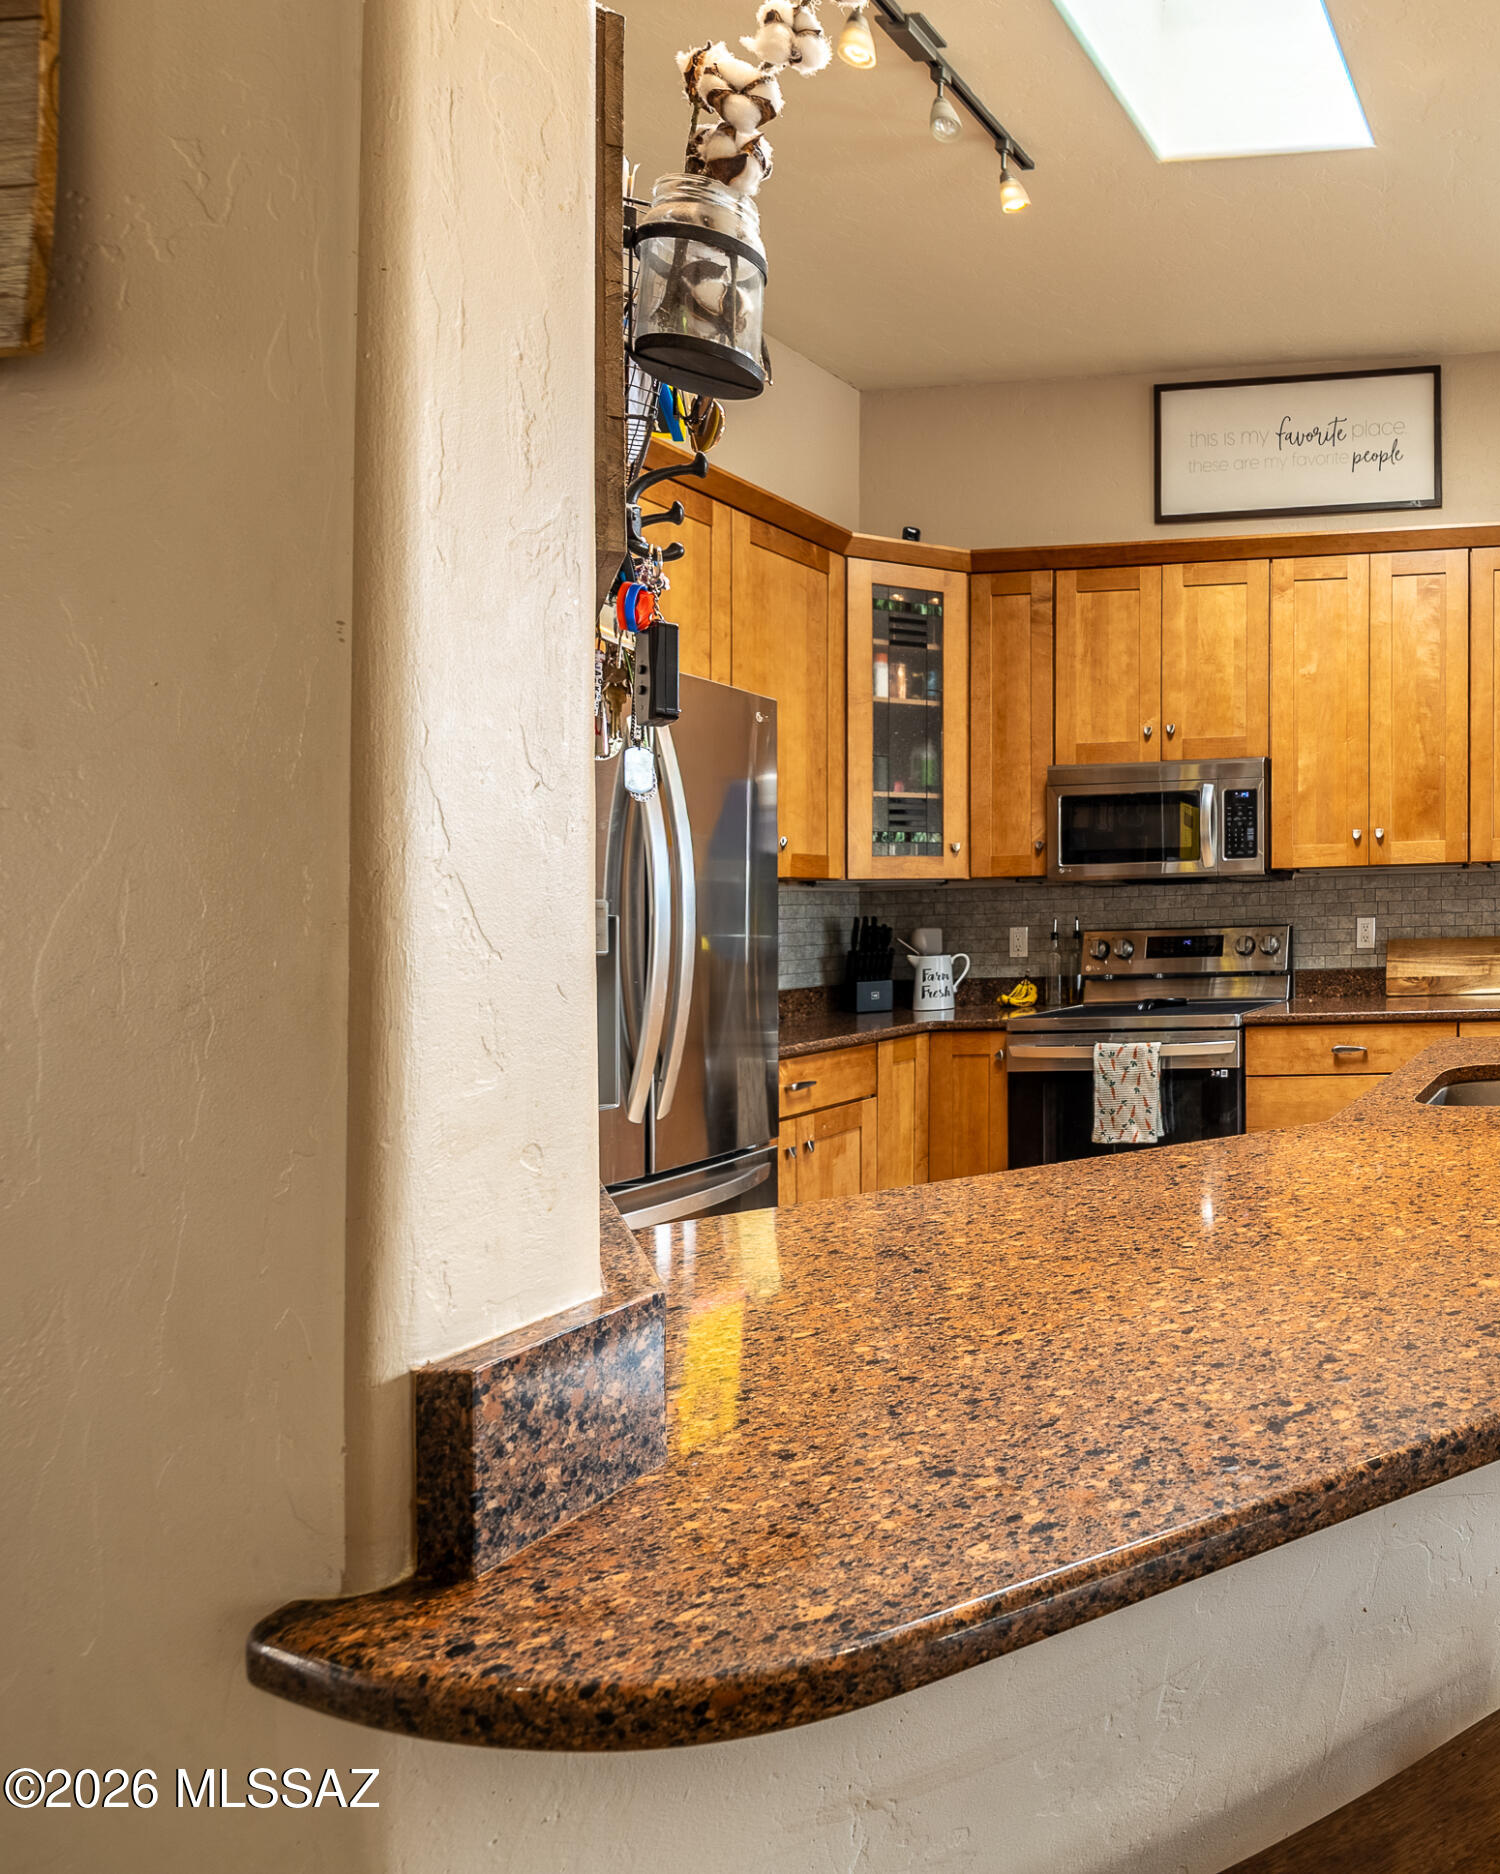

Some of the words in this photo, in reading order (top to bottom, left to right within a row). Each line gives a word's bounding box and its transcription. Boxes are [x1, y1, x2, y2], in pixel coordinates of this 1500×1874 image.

[1190, 431, 1217, 448] this
[1224, 431, 1235, 447] is
[1240, 430, 1268, 450] my
[1276, 416, 1347, 450] favorite
[1352, 420, 1405, 440] place
[1189, 458, 1229, 473] these
[1233, 458, 1259, 470] are
[1264, 455, 1287, 470] my
[1292, 451, 1348, 467] favorite
[1352, 438, 1404, 472] people
[923, 968, 949, 982] Farm
[922, 985, 950, 999] Fresh
